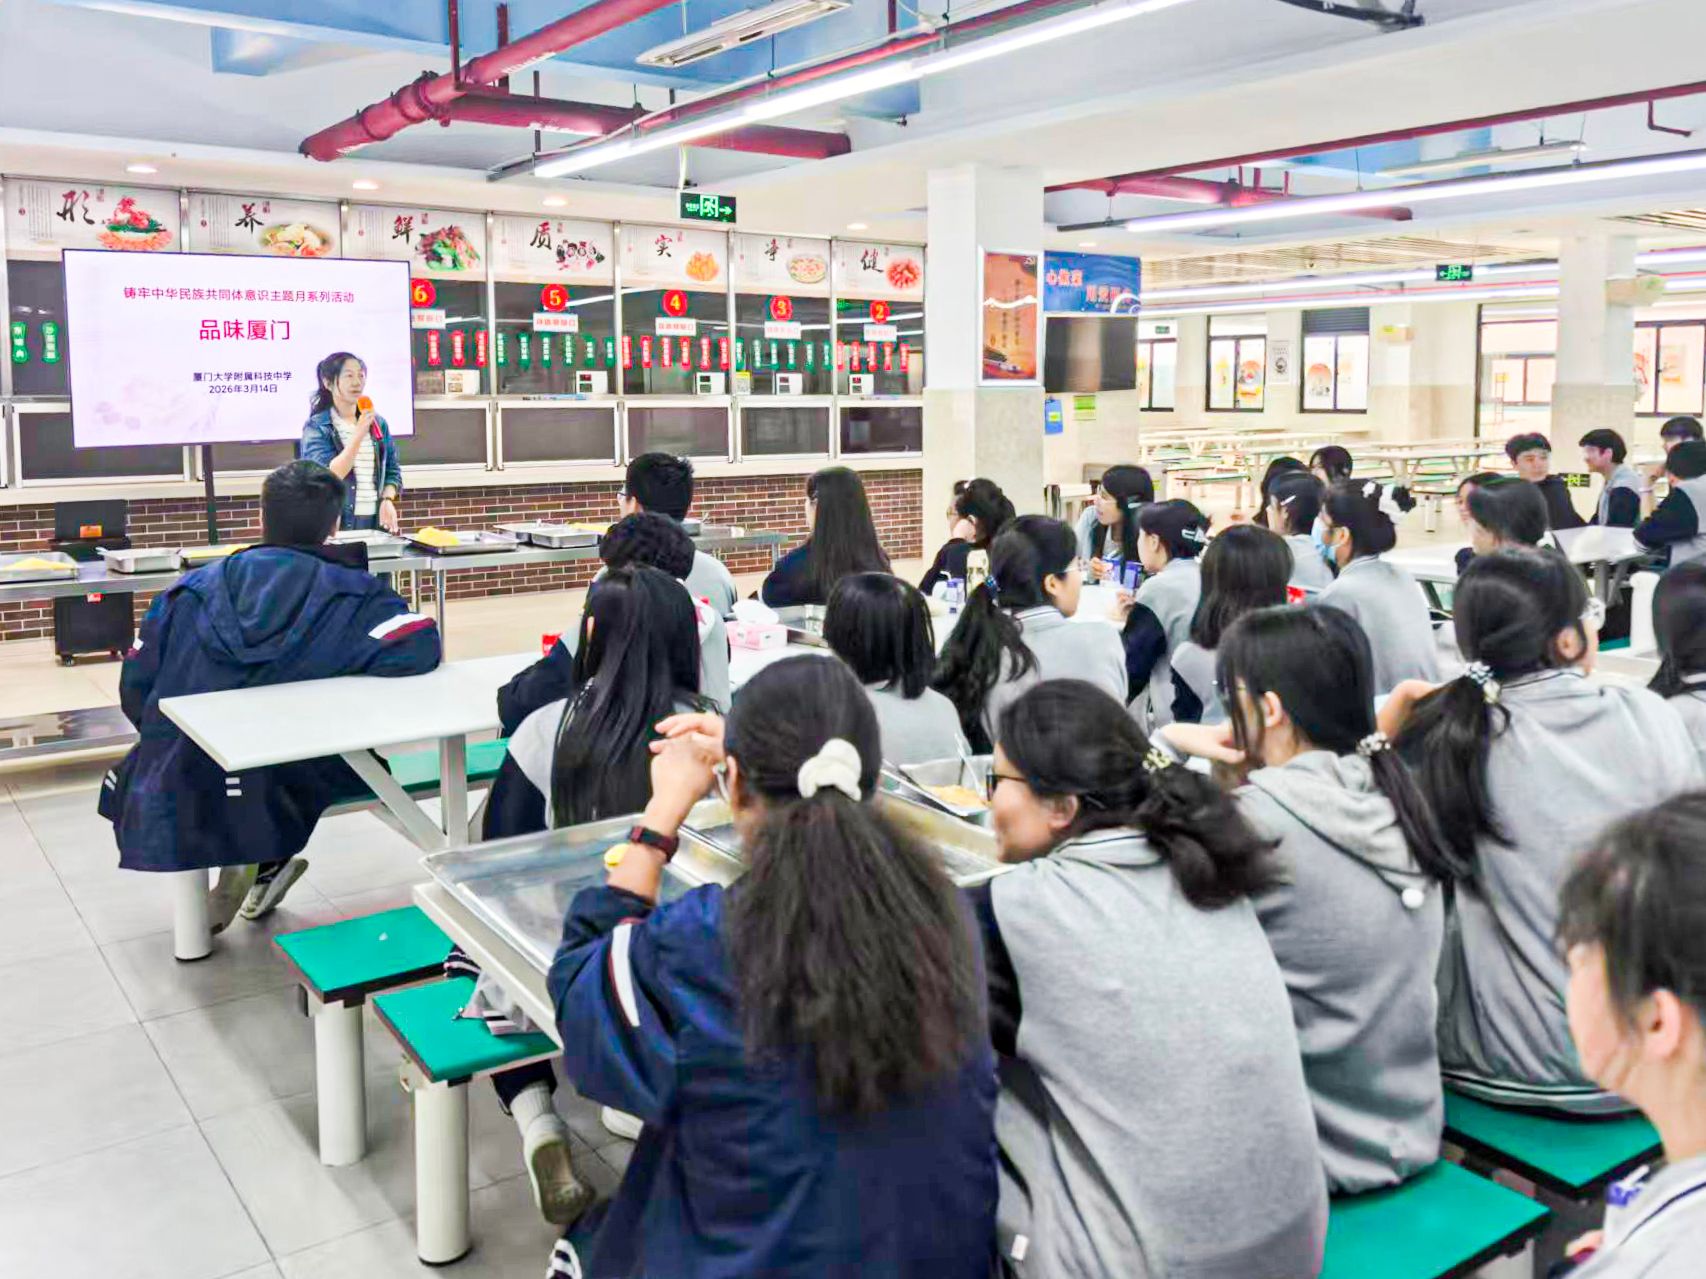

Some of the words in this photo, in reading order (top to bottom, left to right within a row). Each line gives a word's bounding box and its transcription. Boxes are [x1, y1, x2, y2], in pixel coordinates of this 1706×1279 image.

[391, 215, 414, 244] 鲜
[529, 221, 552, 250] 质
[123, 287, 355, 303] 铸牢中华民族共同体意识主题月系列活动
[413, 285, 428, 302] 6
[548, 289, 562, 306] 5
[669, 294, 681, 310] 4
[776, 301, 787, 316] 3
[875, 303, 885, 319] 2
[199, 318, 291, 341] 品味厦门
[193, 371, 293, 382] 厦门大学附属科技中学
[209, 383, 278, 394] 2026年3月14日
